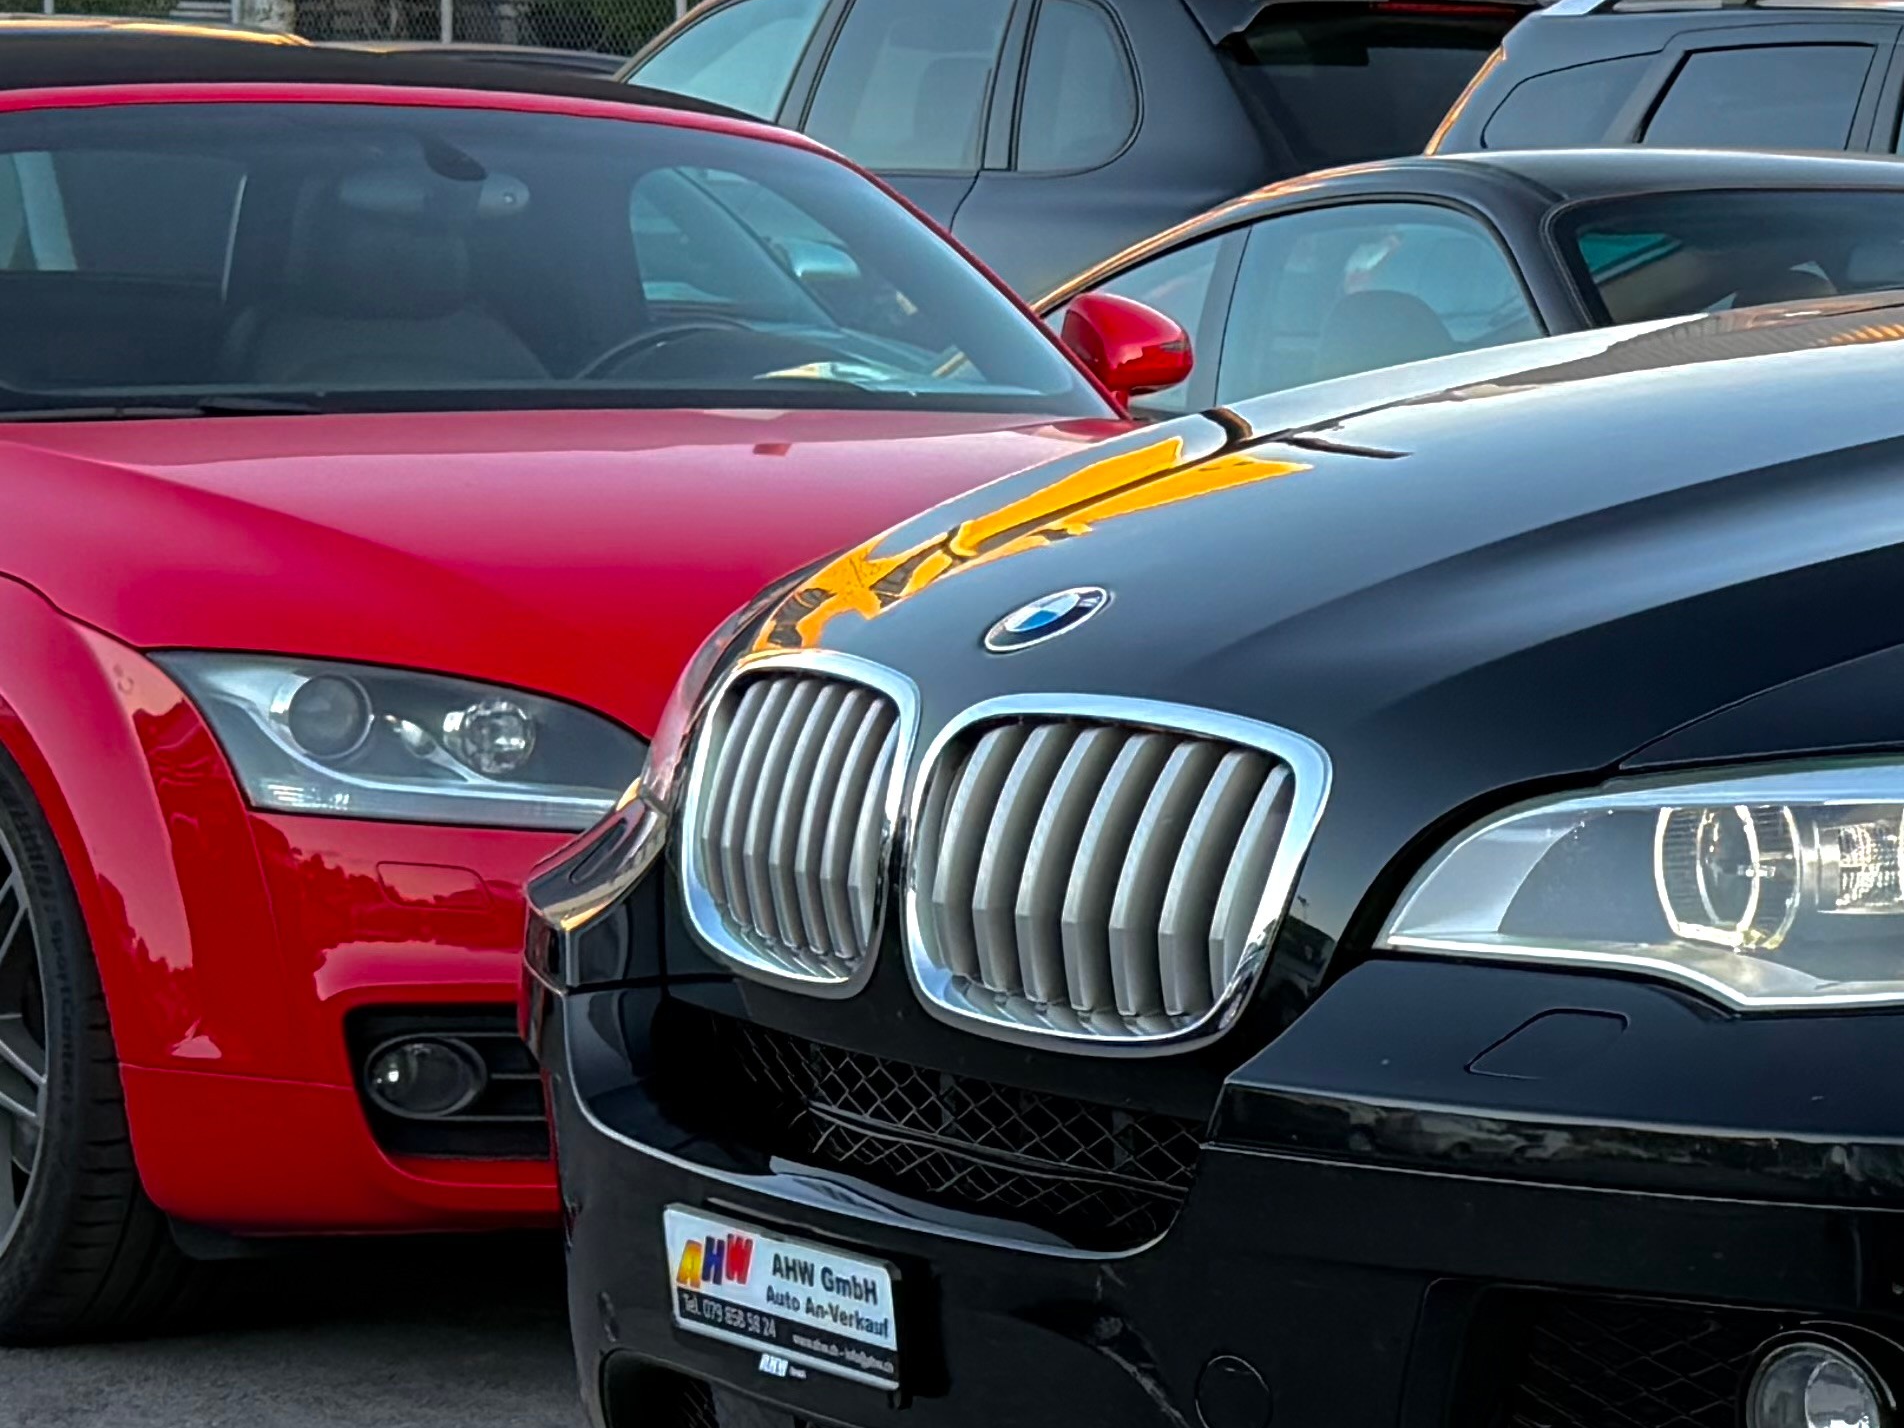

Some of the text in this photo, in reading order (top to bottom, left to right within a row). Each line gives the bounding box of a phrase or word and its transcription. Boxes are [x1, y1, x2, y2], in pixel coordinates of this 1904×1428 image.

[676, 1232, 754, 1289] AHW
[772, 1253, 878, 1306] AHW GmbH
[766, 1285, 889, 1339] Auto An-Verkauf
